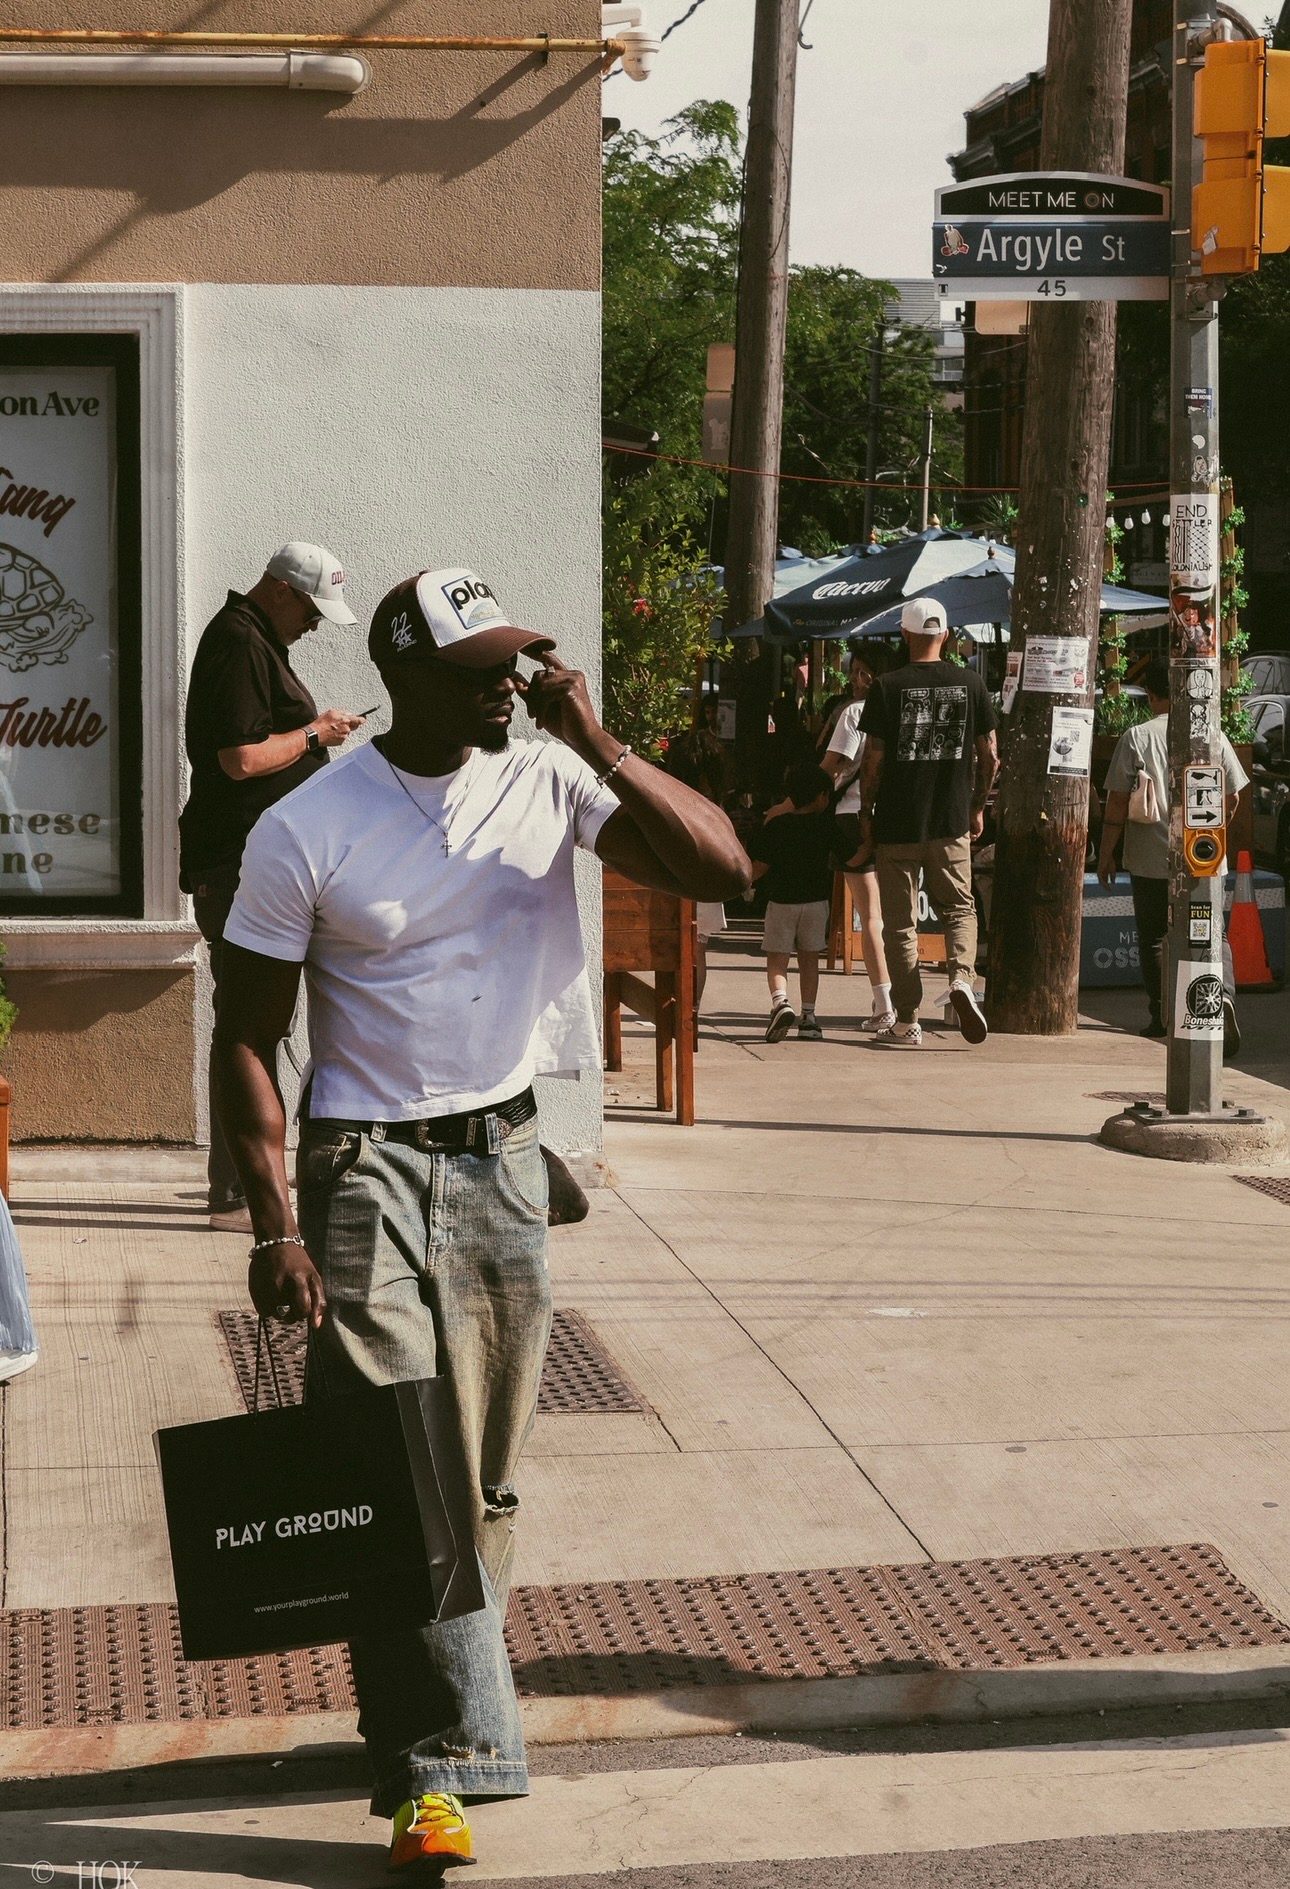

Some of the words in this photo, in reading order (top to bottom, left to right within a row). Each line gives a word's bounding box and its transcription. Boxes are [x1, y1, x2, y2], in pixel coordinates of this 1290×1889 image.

[989, 191, 1043, 209] MEET
[1048, 191, 1076, 209] ME
[1085, 191, 1115, 209] ON
[976, 228, 1083, 272] Argyle
[1102, 235, 1125, 261] St
[1037, 280, 1067, 297] 45
[41, 391, 100, 417] Ave
[1176, 504, 1208, 519] END
[0, 697, 108, 748] Turtle
[1191, 910, 1210, 918] FUN
[215, 1520, 267, 1550] PLAY
[275, 1504, 373, 1538] GROUND
[253, 1591, 350, 1614] www.yourplayground.world
